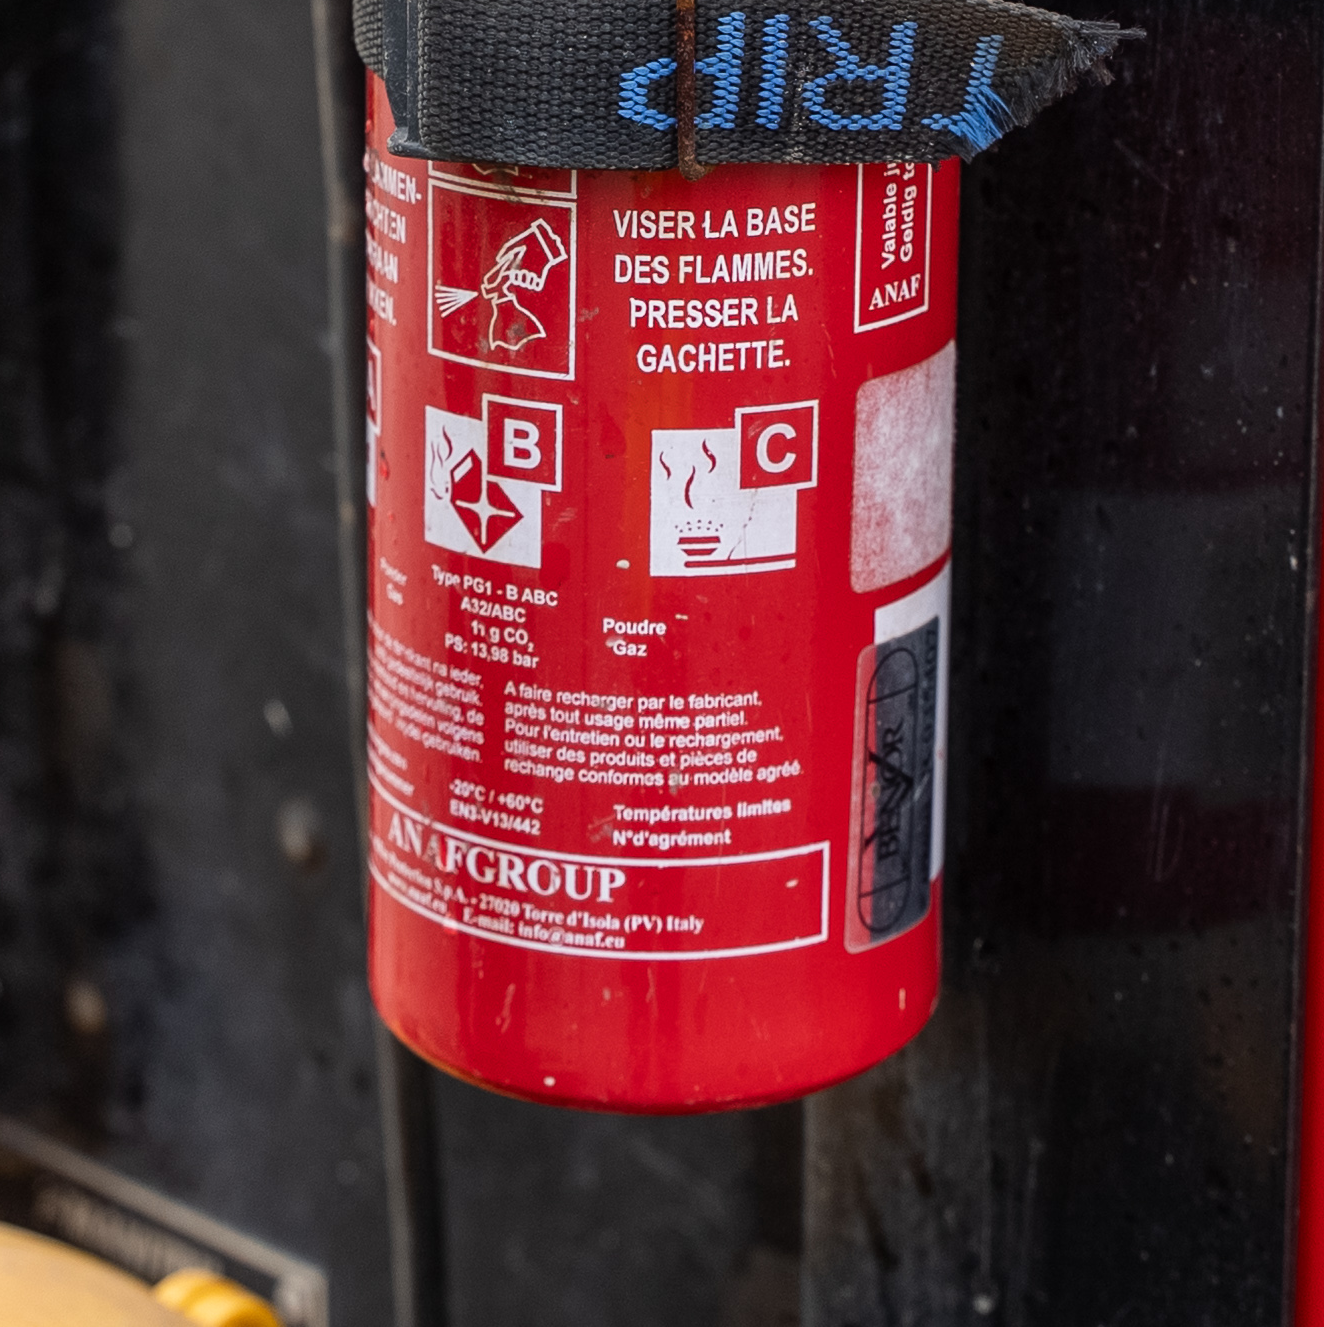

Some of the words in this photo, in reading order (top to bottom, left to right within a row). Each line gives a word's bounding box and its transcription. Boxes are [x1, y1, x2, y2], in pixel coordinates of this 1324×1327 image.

[613, 209, 696, 239] VISER
[702, 210, 739, 239] LA
[746, 202, 817, 236] BASE
[881, 183, 897, 270] Valable
[900, 185, 917, 263] Geldig
[614, 254, 670, 284] DES
[678, 248, 814, 284] FLAMMES.
[868, 273, 921, 310] ANAF
[629, 297, 759, 329] PRESSER
[766, 293, 799, 324] LA
[636, 339, 791, 373] GACHETTE.
[503, 418, 542, 470] B
[756, 423, 797, 473] C
[432, 564, 461, 587] Type
[463, 575, 492, 595] PG1
[505, 584, 518, 600] B
[522, 588, 559, 607] ABC
[460, 597, 527, 623] A32/ABC
[603, 618, 667, 636] Poudre
[444, 632, 468, 654] PS:
[471, 641, 509, 663] 13,98
[512, 651, 540, 669] bar
[489, 627, 500, 643] g
[613, 639, 647, 657] Gaz
[504, 681, 516, 696] A
[519, 683, 552, 702] faire
[556, 691, 633, 712] recharger
[638, 696, 665, 712] par
[669, 694, 684, 710] le
[505, 701, 546, 720] après
[550, 706, 580, 724] tout
[584, 711, 634, 731] usage
[639, 713, 690, 730] même
[694, 711, 748, 731] partiel.
[505, 718, 540, 738] Pour
[543, 725, 620, 747] l'entretien
[624, 734, 646, 747] ou
[650, 732, 665, 748] le
[504, 740, 553, 760] utiliser
[556, 746, 585, 763] des
[590, 749, 655, 768] produits
[659, 752, 676, 767] et
[680, 750, 732, 770] pièces
[736, 748, 757, 764] de
[504, 757, 575, 783] rechange
[578, 768, 663, 787] conformes
[668, 773, 689, 786] au
[693, 765, 753, 785] modèle
[498, 792, 544, 814] +60°C
[613, 803, 732, 825] Températures
[736, 798, 792, 818] limites
[388, 812, 625, 902] ANAFGROUP
[479, 892, 520, 918] 27020
[523, 903, 564, 926] Torre
[567, 911, 620, 930] d'Isola
[624, 915, 663, 933] (PV)
[666, 915, 704, 934] Italy
[519, 921, 625, 950] info@anaf.eu
